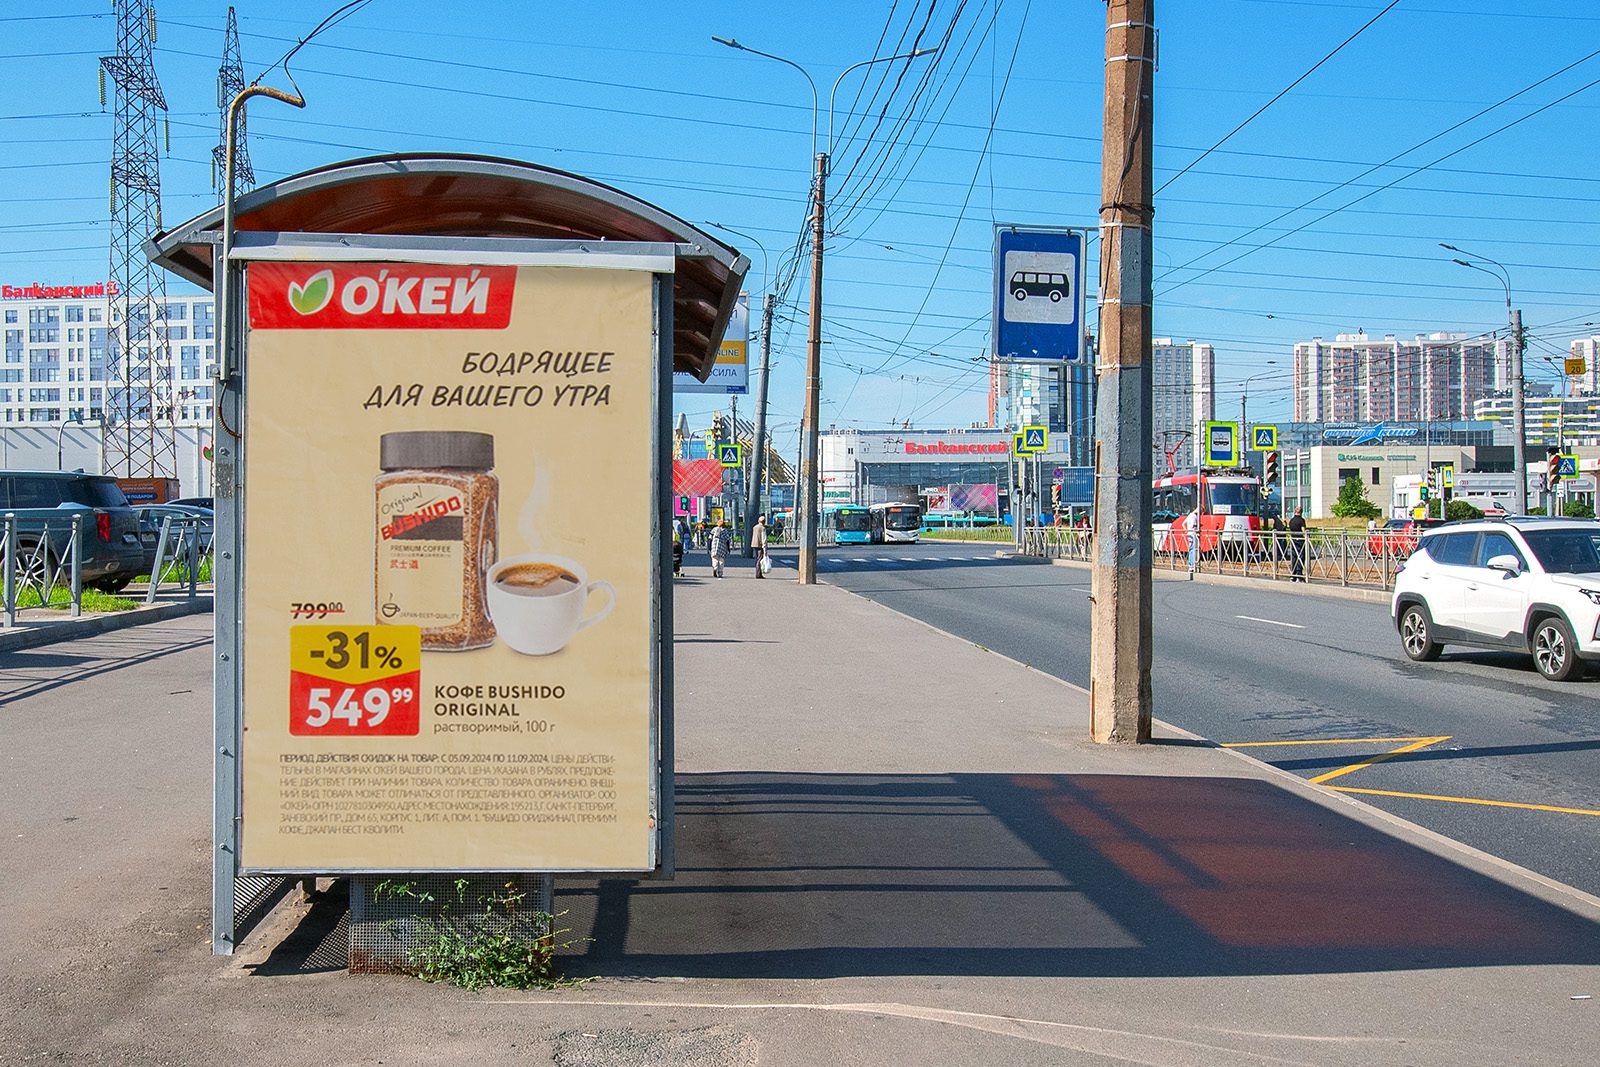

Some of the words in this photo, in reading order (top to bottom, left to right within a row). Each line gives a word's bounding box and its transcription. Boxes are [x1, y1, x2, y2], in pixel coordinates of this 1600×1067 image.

[2, 282, 104, 298] Балканский
[461, 351, 614, 376] БОДРЯЩЕЕ
[363, 384, 425, 411] ДЛЯ
[431, 384, 543, 407] ВАШЕГО
[552, 384, 611, 406] УТРА
[905, 441, 1008, 454] Балканский
[381, 496, 462, 540] BUSHIDO
[310, 631, 402, 670] -31%
[434, 685, 483, 699] КОФЕ
[489, 685, 565, 699] BUSHIDO
[434, 703, 520, 716] ORIGINAL
[434, 719, 523, 734] растворимый,
[526, 720, 548, 732] 100
[549, 723, 556, 732] г
[280, 753, 314, 763] ПЕРИОД
[316, 753, 359, 763] ДЕЙСТВИЯ
[361, 753, 395, 763] СКИДОК
[397, 753, 409, 763] НА
[441, 753, 447, 763] С
[448, 753, 491, 763] 05.09.2024
[493, 753, 505, 763] ПО
[551, 753, 575, 763] ЦЕНЫ
[323, 765, 371, 775] МАГАЗИНАХ
[399, 765, 432, 775] ВАШЕГО
[469, 765, 491, 775] ЦЕНА
[493, 765, 528, 775] УКАЗАНА
[280, 777, 297, 786] НИЕ
[299, 777, 346, 786] ДЕЙСТВУЕТ
[348, 777, 366, 786] ПРИ
[368, 777, 409, 786] НАЛИЧИИ
[446, 777, 499, 786] КОЛИЧЕСТВО
[502, 777, 532, 786] ТОВАРА
[280, 788, 299, 798] НИЙ
[301, 788, 320, 798] ВИД
[322, 788, 352, 798] ТОВАРА
[355, 788, 386, 798] МОЖЕТ
[388, 788, 441, 798] ОТЛИЧАТЬСЯ
[443, 788, 454, 798] ОТ
[598, 788, 616, 798] ООО
[280, 813, 328, 823] ЗАНЕВСКИЙ
[345, 813, 365, 823] ДОМ
[342, 825, 362, 834] БЕСТ
